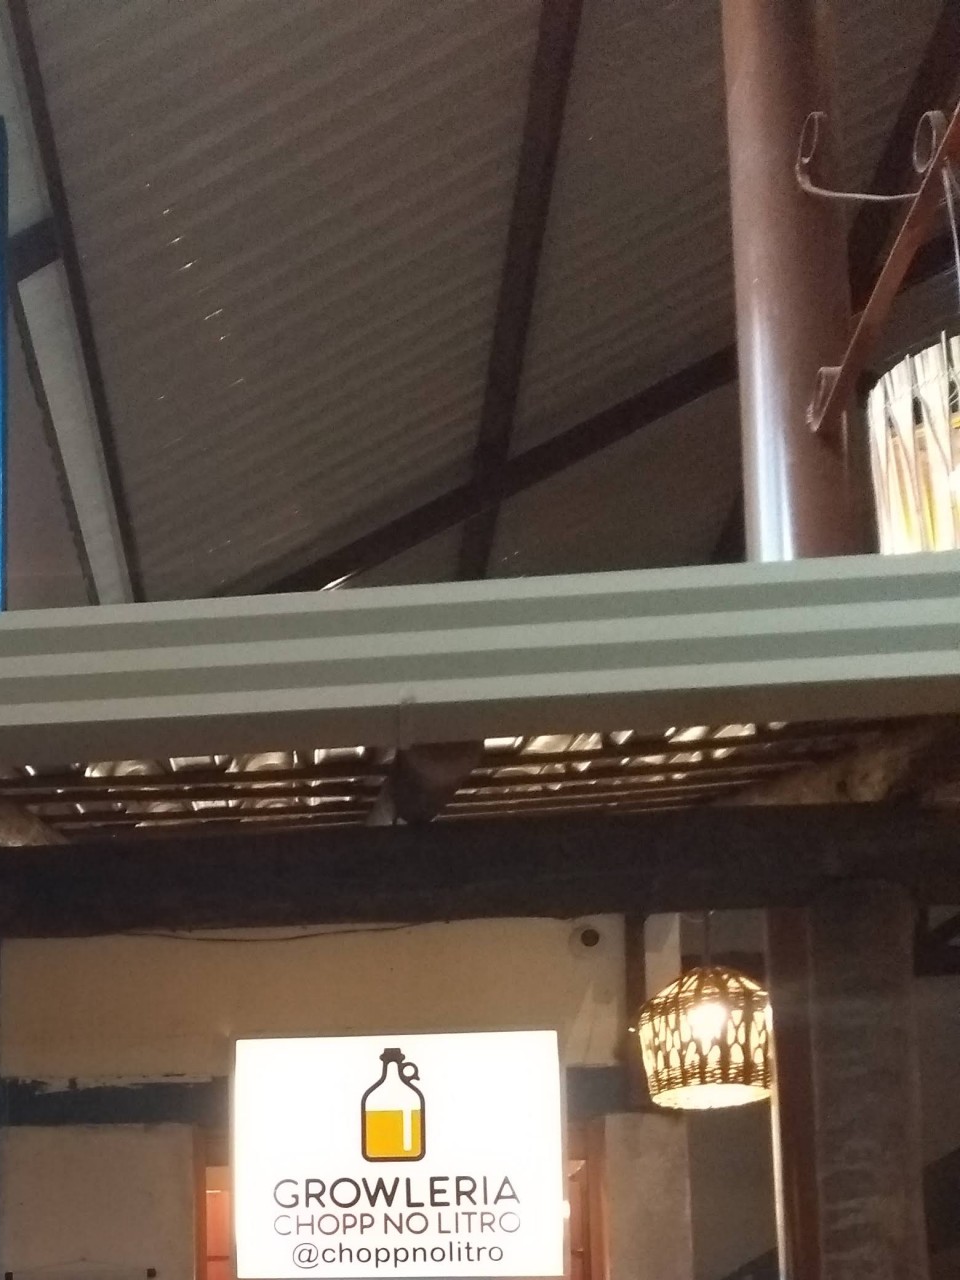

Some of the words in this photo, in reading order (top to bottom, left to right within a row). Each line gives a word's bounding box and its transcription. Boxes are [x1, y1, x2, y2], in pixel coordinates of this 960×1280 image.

[273, 1175, 521, 1209] GROWLERIA
[273, 1213, 375, 1236] CHOPP
[384, 1212, 429, 1235] NO
[437, 1211, 521, 1234] LITRO
[292, 1241, 504, 1269] @choppnolitro
